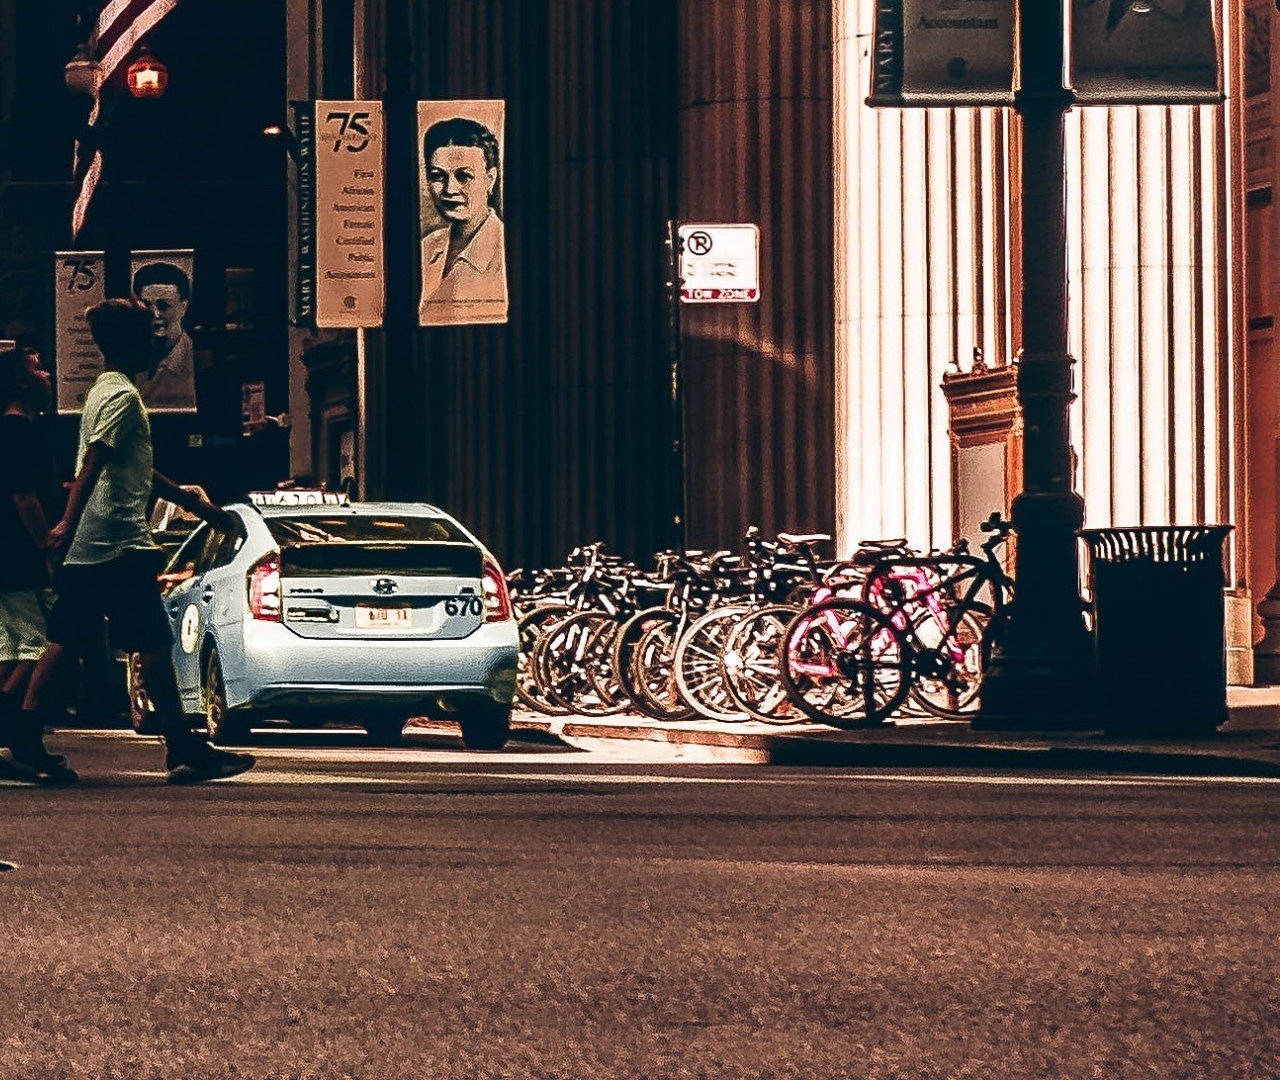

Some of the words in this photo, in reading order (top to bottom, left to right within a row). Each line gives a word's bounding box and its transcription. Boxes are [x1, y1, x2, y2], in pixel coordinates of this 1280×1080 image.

[326, 112, 370, 152] 75
[62, 260, 96, 293] 75
[444, 597, 484, 617] 670
